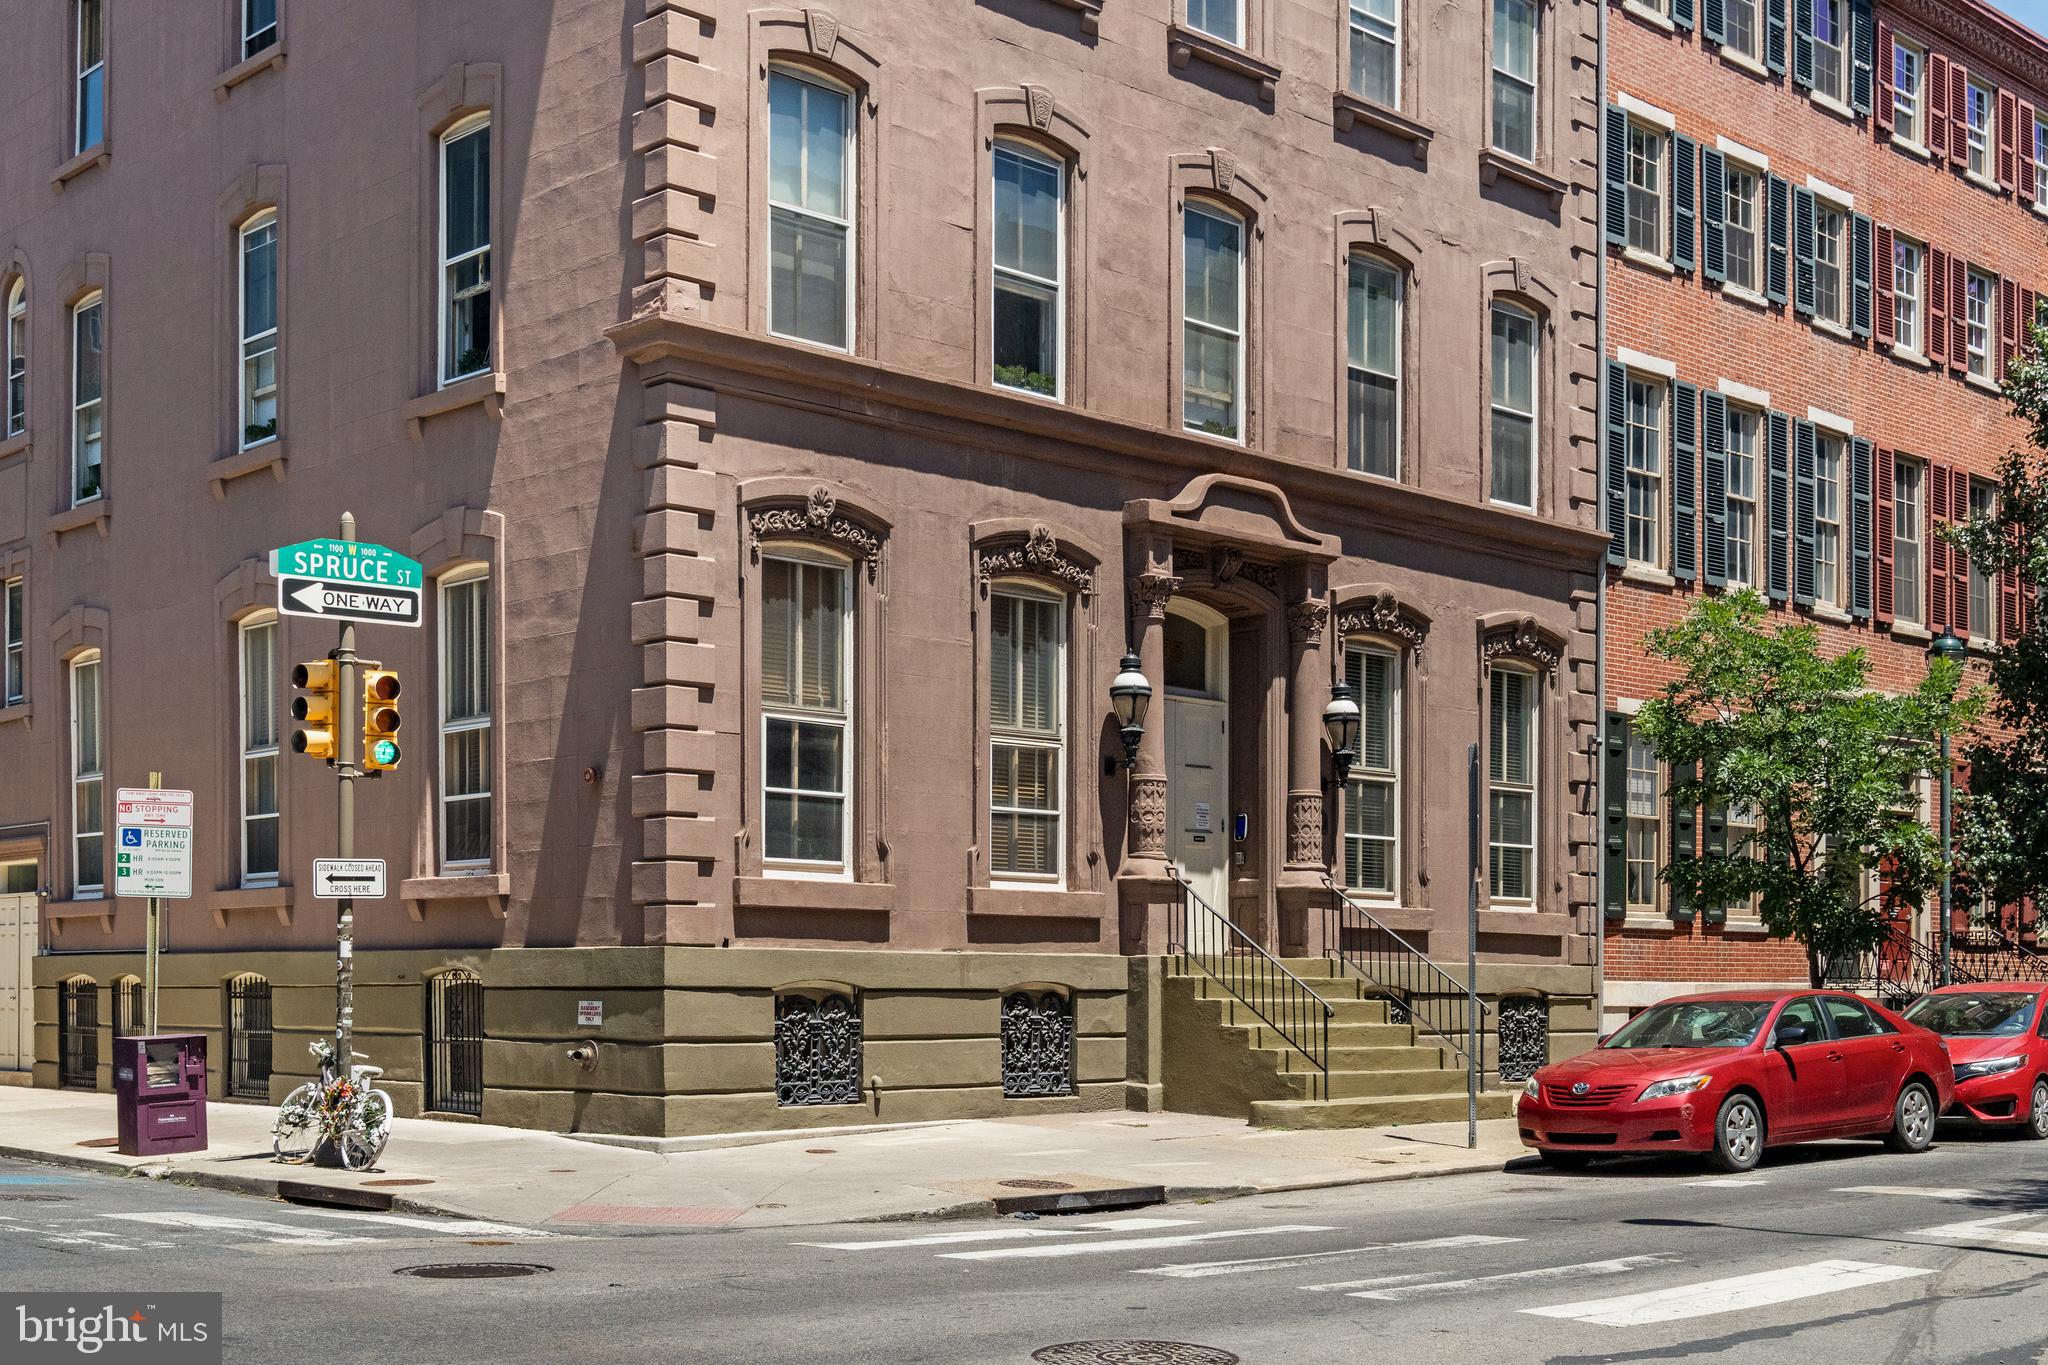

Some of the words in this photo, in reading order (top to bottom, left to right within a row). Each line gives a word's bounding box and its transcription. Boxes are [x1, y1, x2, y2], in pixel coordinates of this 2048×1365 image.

[329, 543, 344, 553] 1100
[348, 544, 357, 556] W
[361, 547, 377, 557] 1000
[294, 551, 389, 583] SPRUCE
[397, 569, 412, 585] ST
[323, 592, 360, 608] ONE
[366, 596, 405, 613] WAY
[119, 804, 132, 813] NO
[135, 805, 179, 814] STOPPING
[143, 829, 188, 839] RESERVED
[146, 840, 186, 849] PARKING
[121, 854, 127, 862] 2
[121, 868, 127, 876] 3
[318, 863, 344, 872] SIDEWALK
[365, 864, 382, 872] AHEAD
[330, 885, 352, 893] CROSS
[353, 885, 371, 893] HERE
